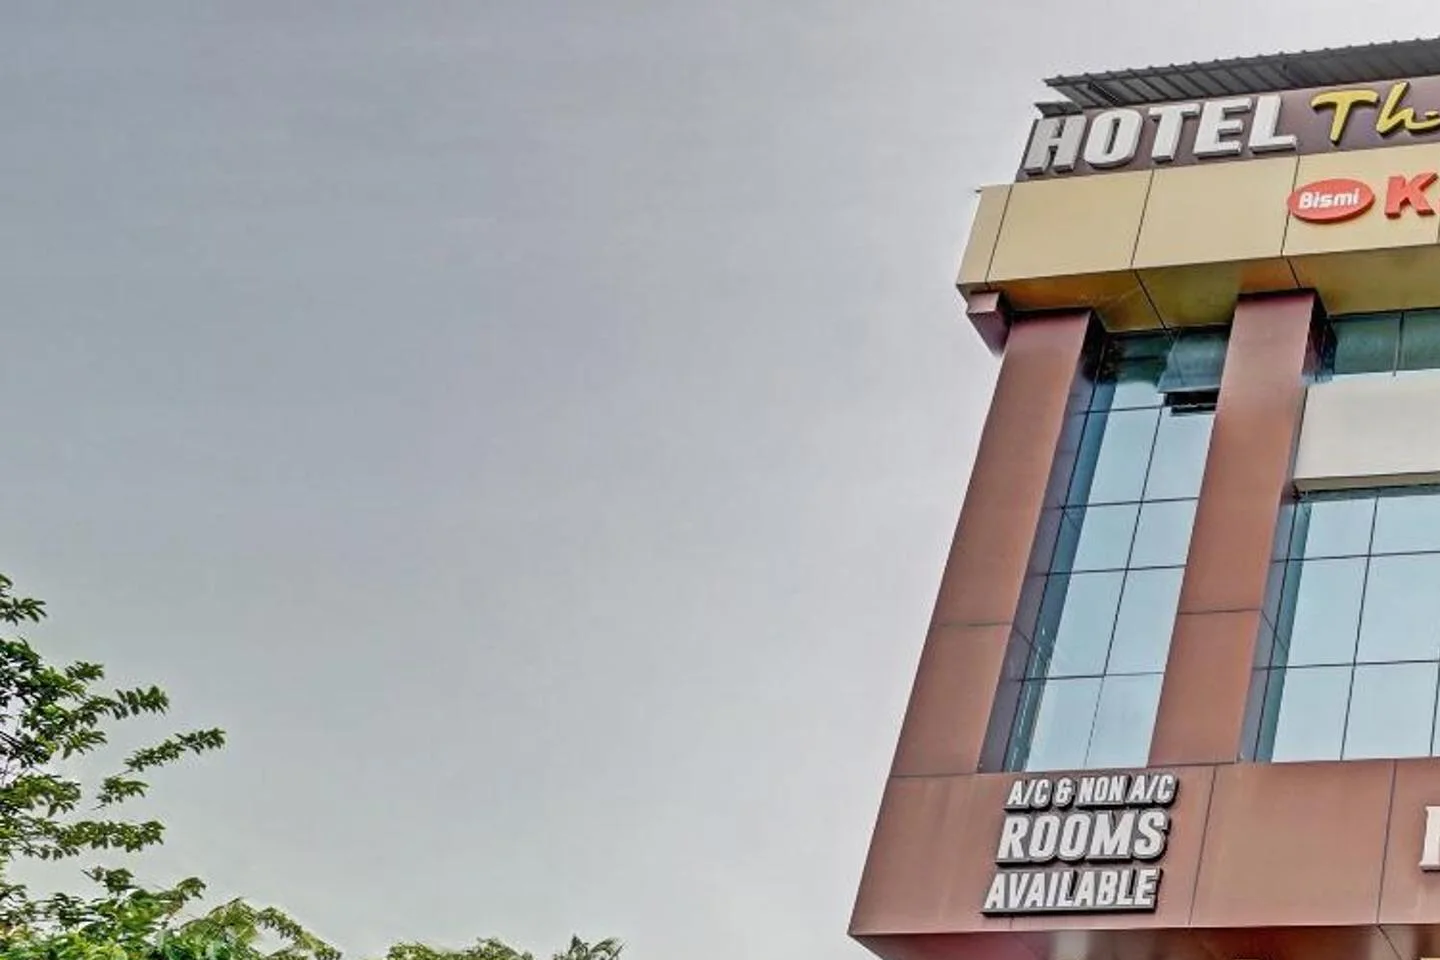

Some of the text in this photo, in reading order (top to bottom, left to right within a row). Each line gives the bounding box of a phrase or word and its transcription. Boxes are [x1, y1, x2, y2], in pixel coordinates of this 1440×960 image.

[1023, 94, 1298, 175] HOTEL
[1298, 187, 1360, 211] Bismi
[1005, 773, 1178, 808] A/C & NON A/C
[997, 810, 1169, 862] ROOMS
[983, 868, 1161, 912] AVAILABLE
